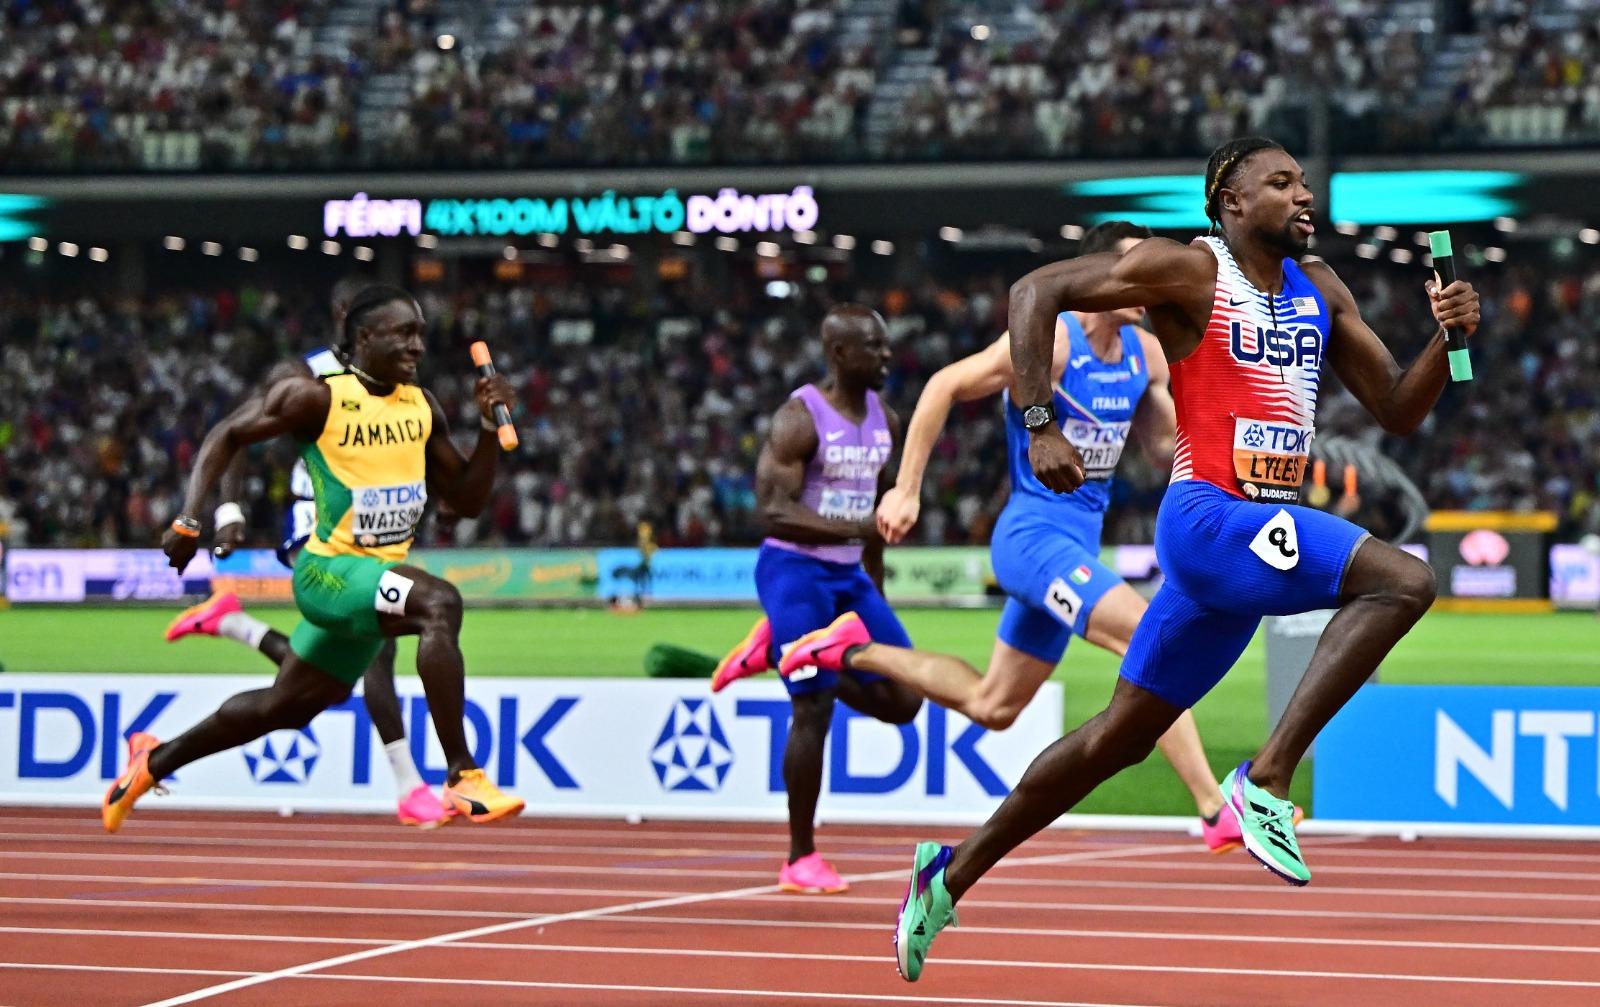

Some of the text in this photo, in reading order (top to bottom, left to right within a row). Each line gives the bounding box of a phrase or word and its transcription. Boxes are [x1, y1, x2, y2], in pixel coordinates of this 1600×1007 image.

[324, 192, 421, 237] FÉRFI
[571, 188, 684, 234] VÁLTÓ
[1230, 320, 1322, 367] USA
[1092, 396, 1130, 411] ITALIA
[1266, 426, 1311, 452] TDK
[825, 445, 889, 463] GREAT
[1250, 454, 1299, 482] LYLES
[379, 485, 422, 505] TDK
[1053, 591, 1073, 613] 5
[736, 699, 1012, 797] TDK
[1434, 707, 1600, 812] NT
